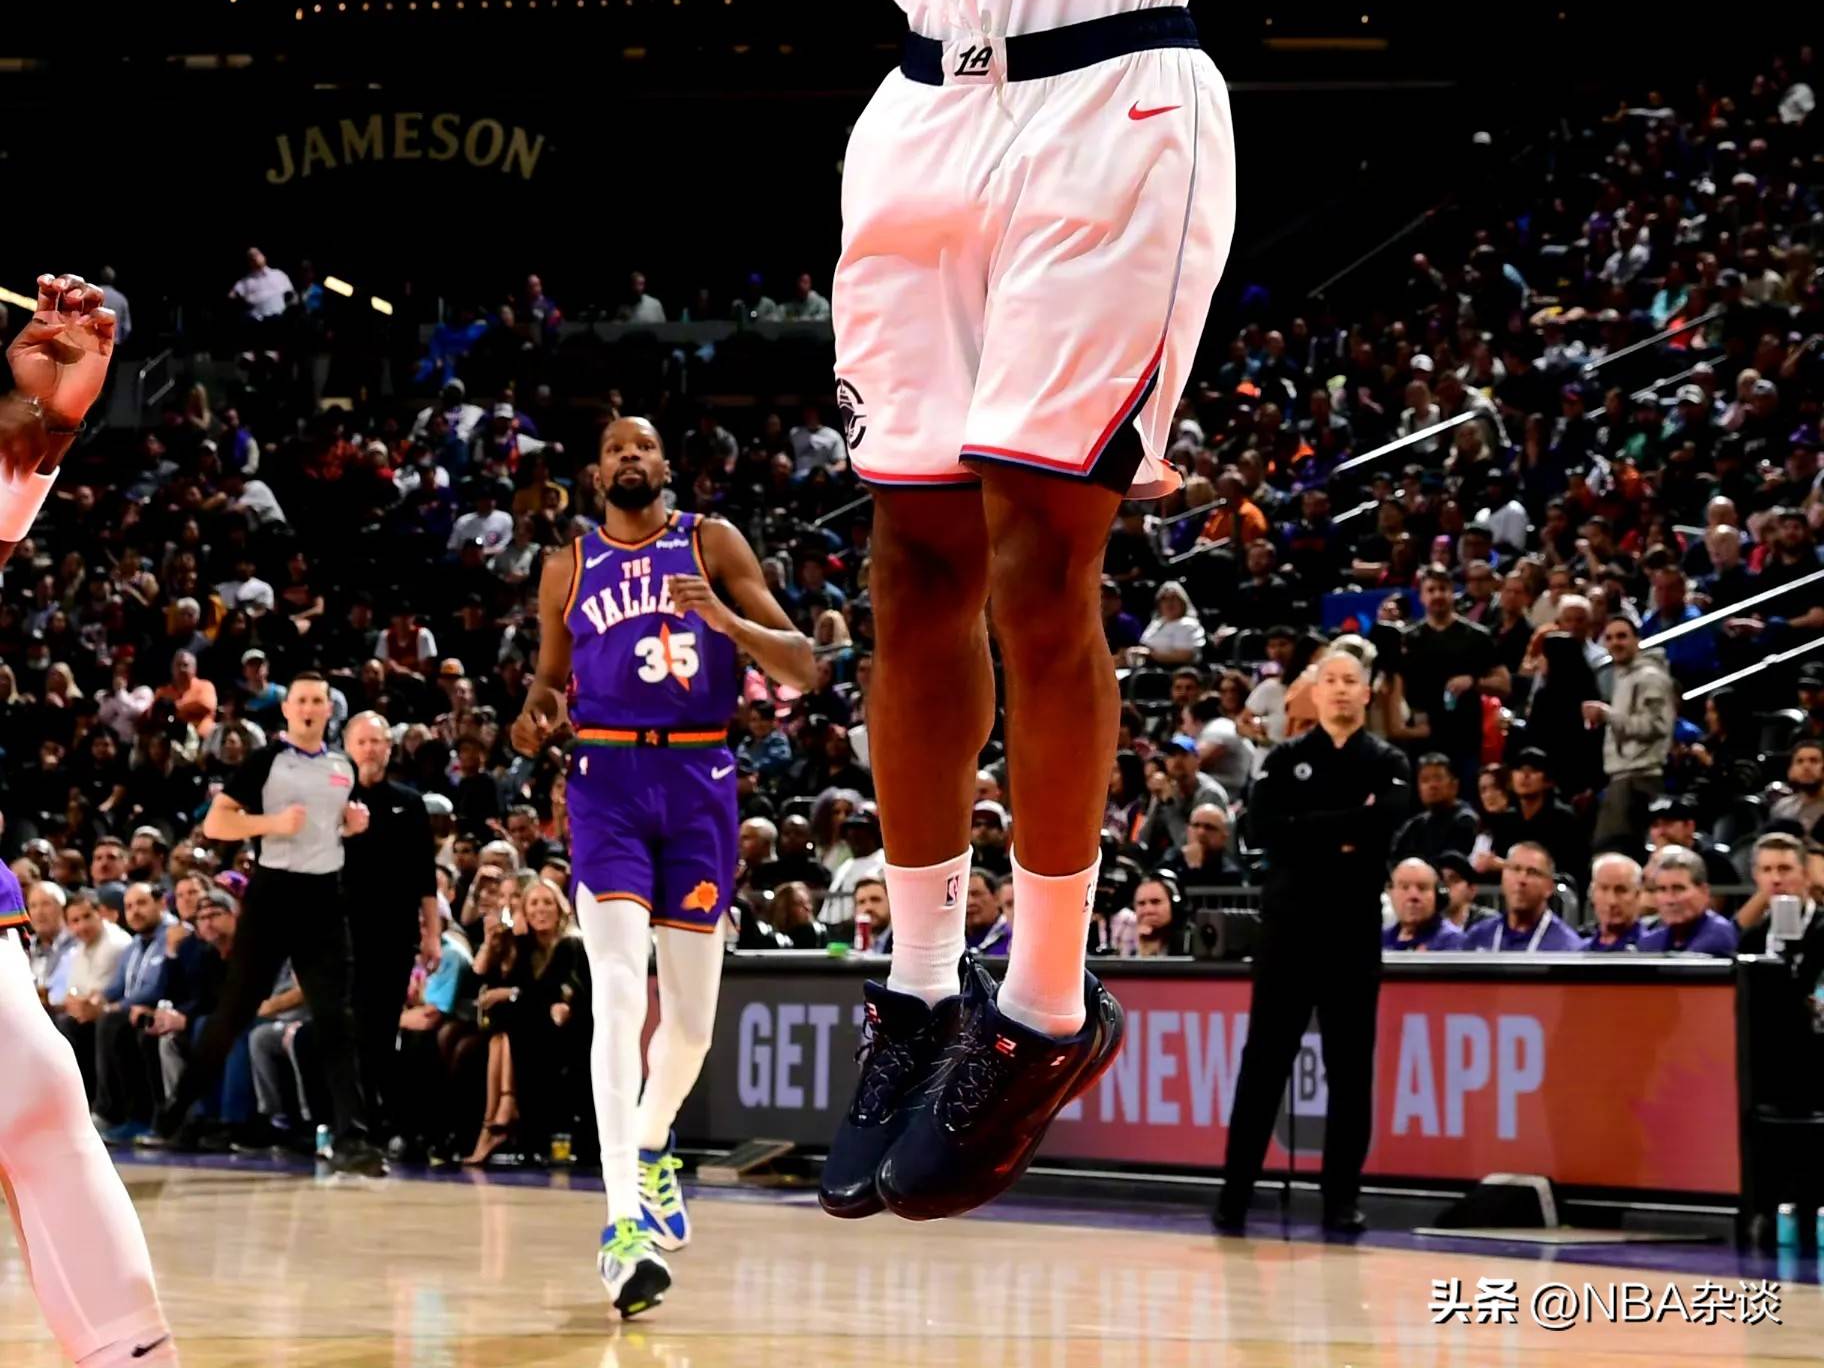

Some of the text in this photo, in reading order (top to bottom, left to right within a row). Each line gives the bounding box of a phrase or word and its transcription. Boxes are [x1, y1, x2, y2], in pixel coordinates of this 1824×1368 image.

[266, 112, 545, 183] JAMESON
[581, 574, 686, 634] VALLE
[634, 632, 700, 683] 35
[738, 1002, 1545, 1139] GET NEW APP
